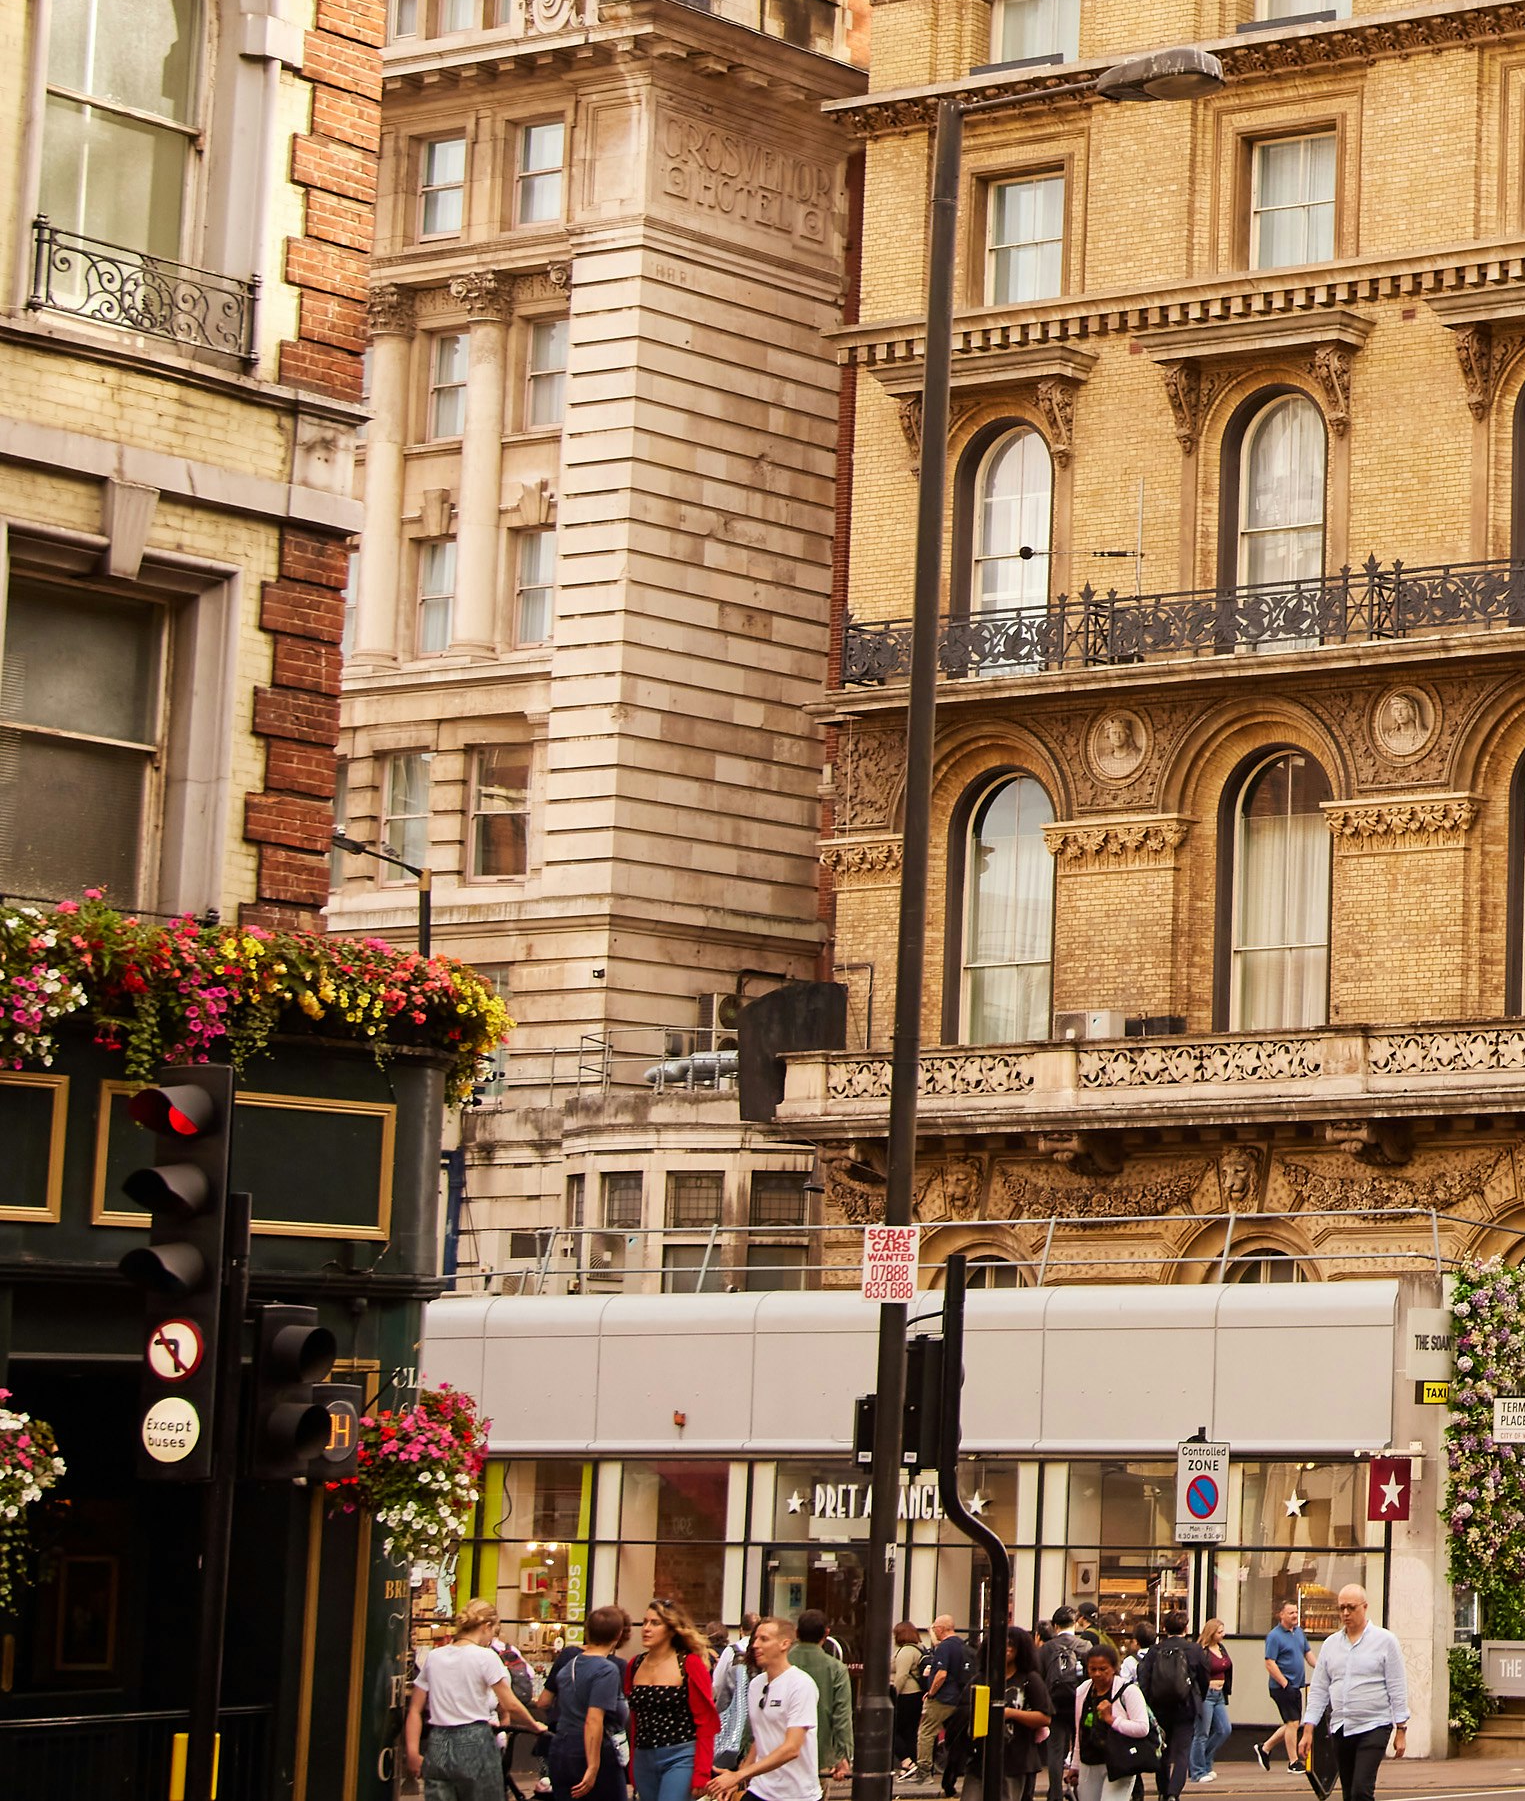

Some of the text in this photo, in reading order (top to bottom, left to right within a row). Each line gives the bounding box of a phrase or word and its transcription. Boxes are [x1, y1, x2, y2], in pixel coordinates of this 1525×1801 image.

[868, 1229, 916, 1240] SCRAP
[872, 1241, 910, 1252] CARS
[867, 1253, 915, 1262] WANTED
[871, 1264, 909, 1282] 07888
[865, 1282, 913, 1299] 833 688
[1415, 1334, 1430, 1350] THE
[1426, 1387, 1446, 1398] TAXI
[147, 1417, 192, 1439] Except
[147, 1435, 186, 1448] buses
[1182, 1446, 1227, 1456] Controlled
[1188, 1459, 1219, 1471] ZONE
[815, 1484, 858, 1518] PRET
[897, 1484, 948, 1520] ANGE
[565, 1564, 586, 1646] scribbl
[1499, 1659, 1522, 1678] THE
